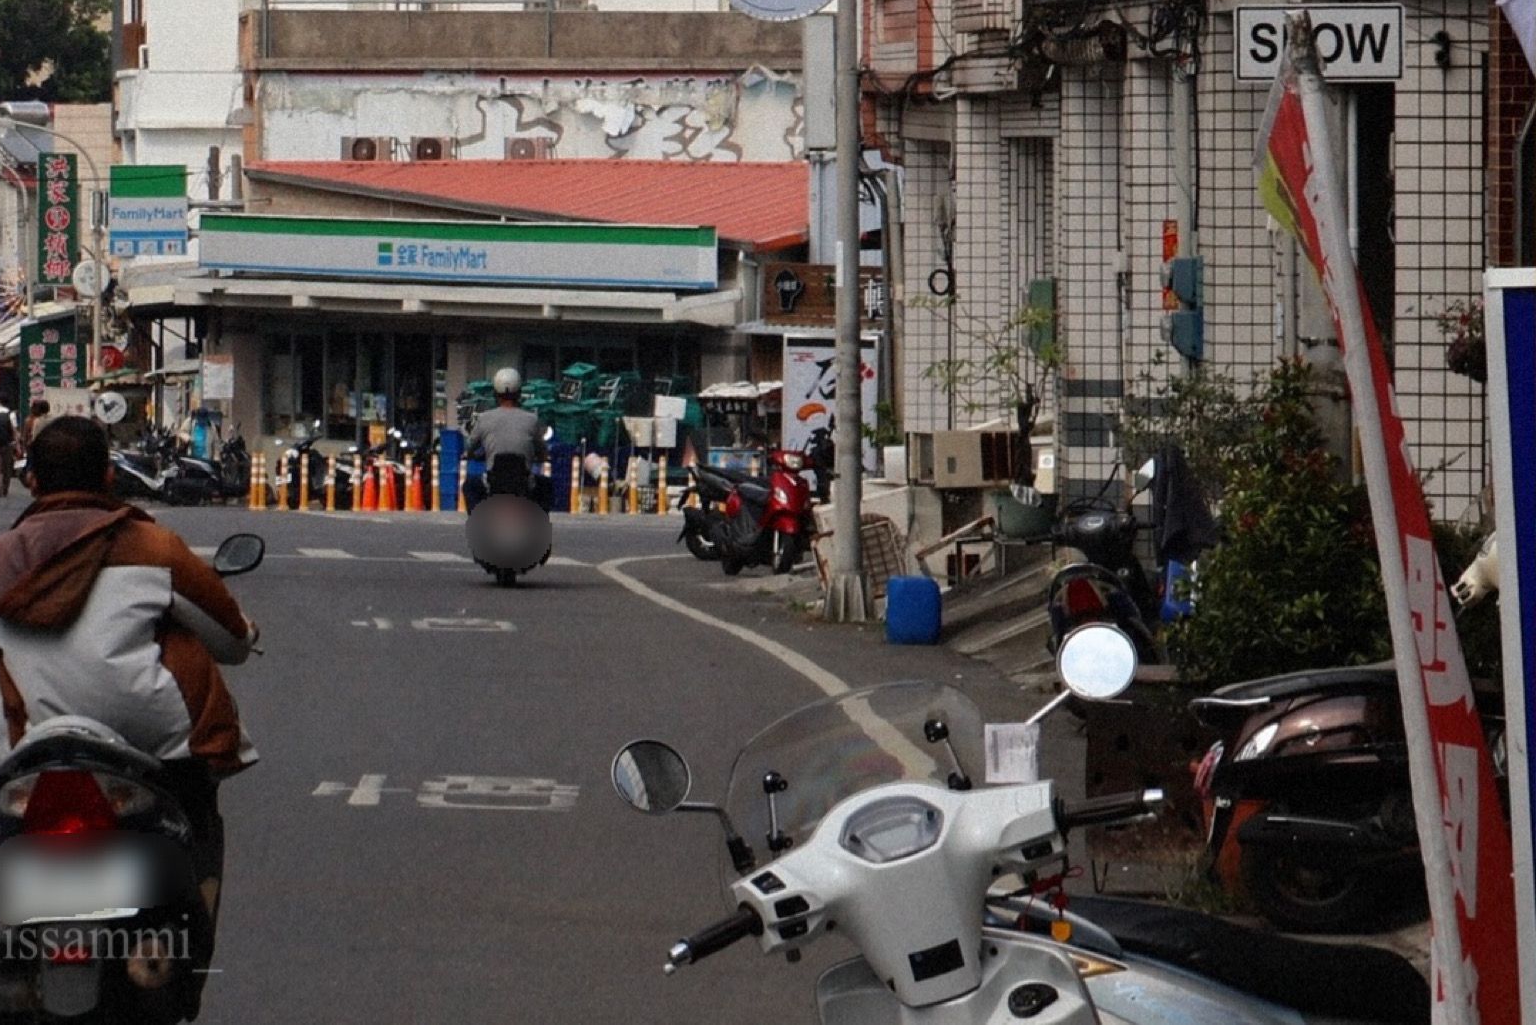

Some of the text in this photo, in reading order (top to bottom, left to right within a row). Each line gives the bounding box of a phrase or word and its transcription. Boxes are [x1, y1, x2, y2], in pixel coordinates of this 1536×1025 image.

[1249, 22, 1391, 65] SOW
[111, 207, 185, 223] FamilyMart
[396, 244, 487, 272] 全家 FamilyMart
